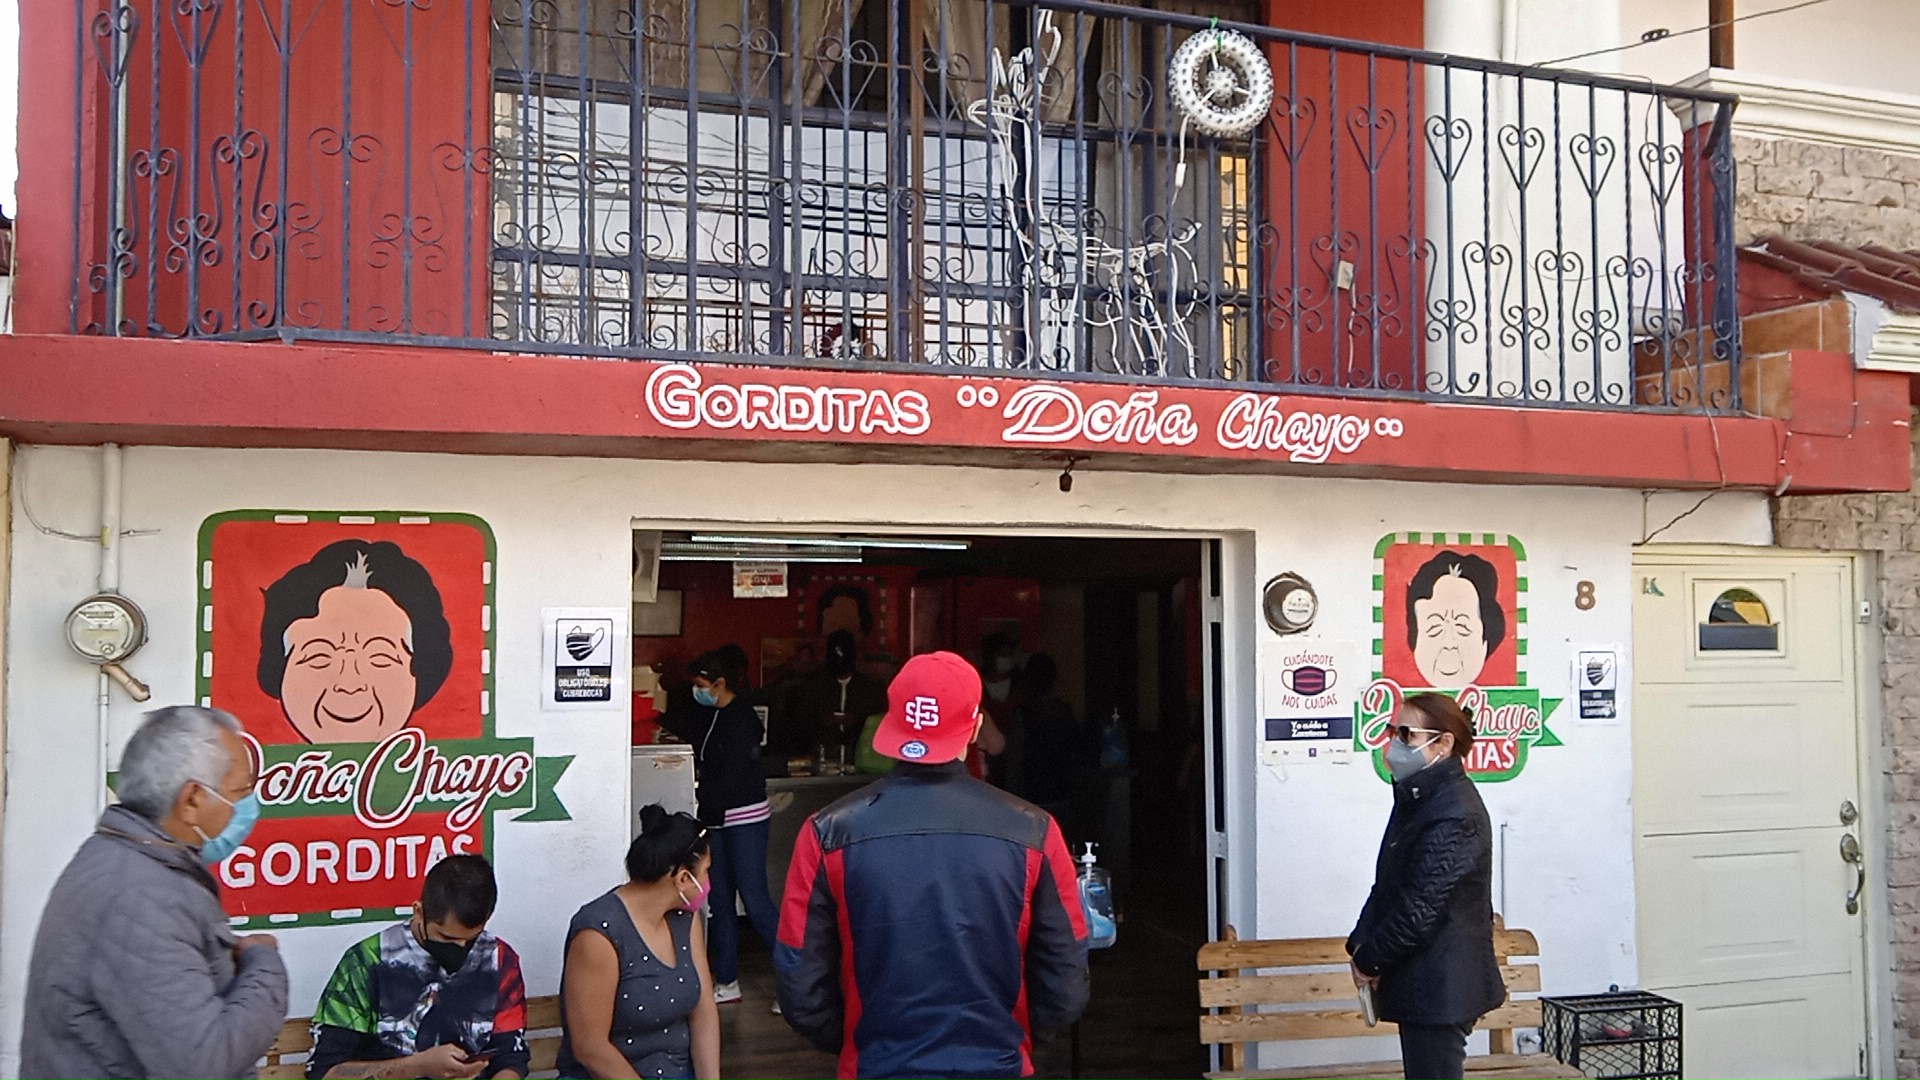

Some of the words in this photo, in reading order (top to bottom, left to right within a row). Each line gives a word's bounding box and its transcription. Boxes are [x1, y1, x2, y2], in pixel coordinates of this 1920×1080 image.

[644, 364, 930, 436] GORDITAS
[1574, 580, 1597, 611] 8
[1284, 650, 1333, 666] CUIDÁNDOTE
[1282, 694, 1300, 709] NOS
[1305, 693, 1338, 709] CUIDAS
[354, 728, 531, 831] Chayo
